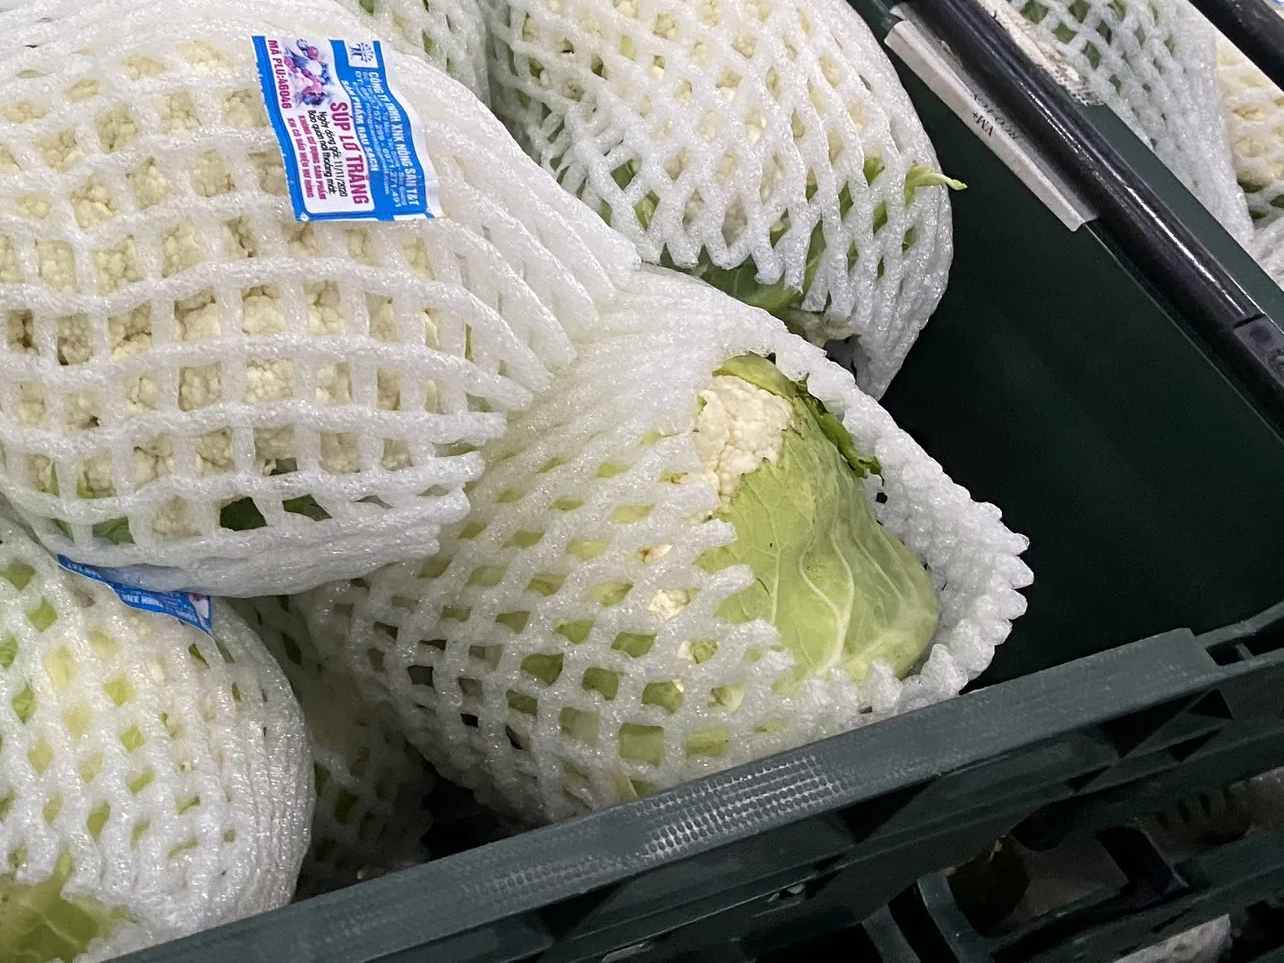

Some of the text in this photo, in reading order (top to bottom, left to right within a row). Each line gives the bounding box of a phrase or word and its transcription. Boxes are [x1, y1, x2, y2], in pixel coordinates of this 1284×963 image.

[267, 40, 281, 55] MÃ
[368, 71, 384, 92] CÔNG
[317, 111, 329, 127] Ngày
[356, 127, 369, 144] RAU
[391, 124, 404, 141] XNK
[329, 102, 369, 205] SÚP LƠ TRẮNG
[395, 144, 412, 166] NÔNG
[405, 188, 419, 205] T&T
